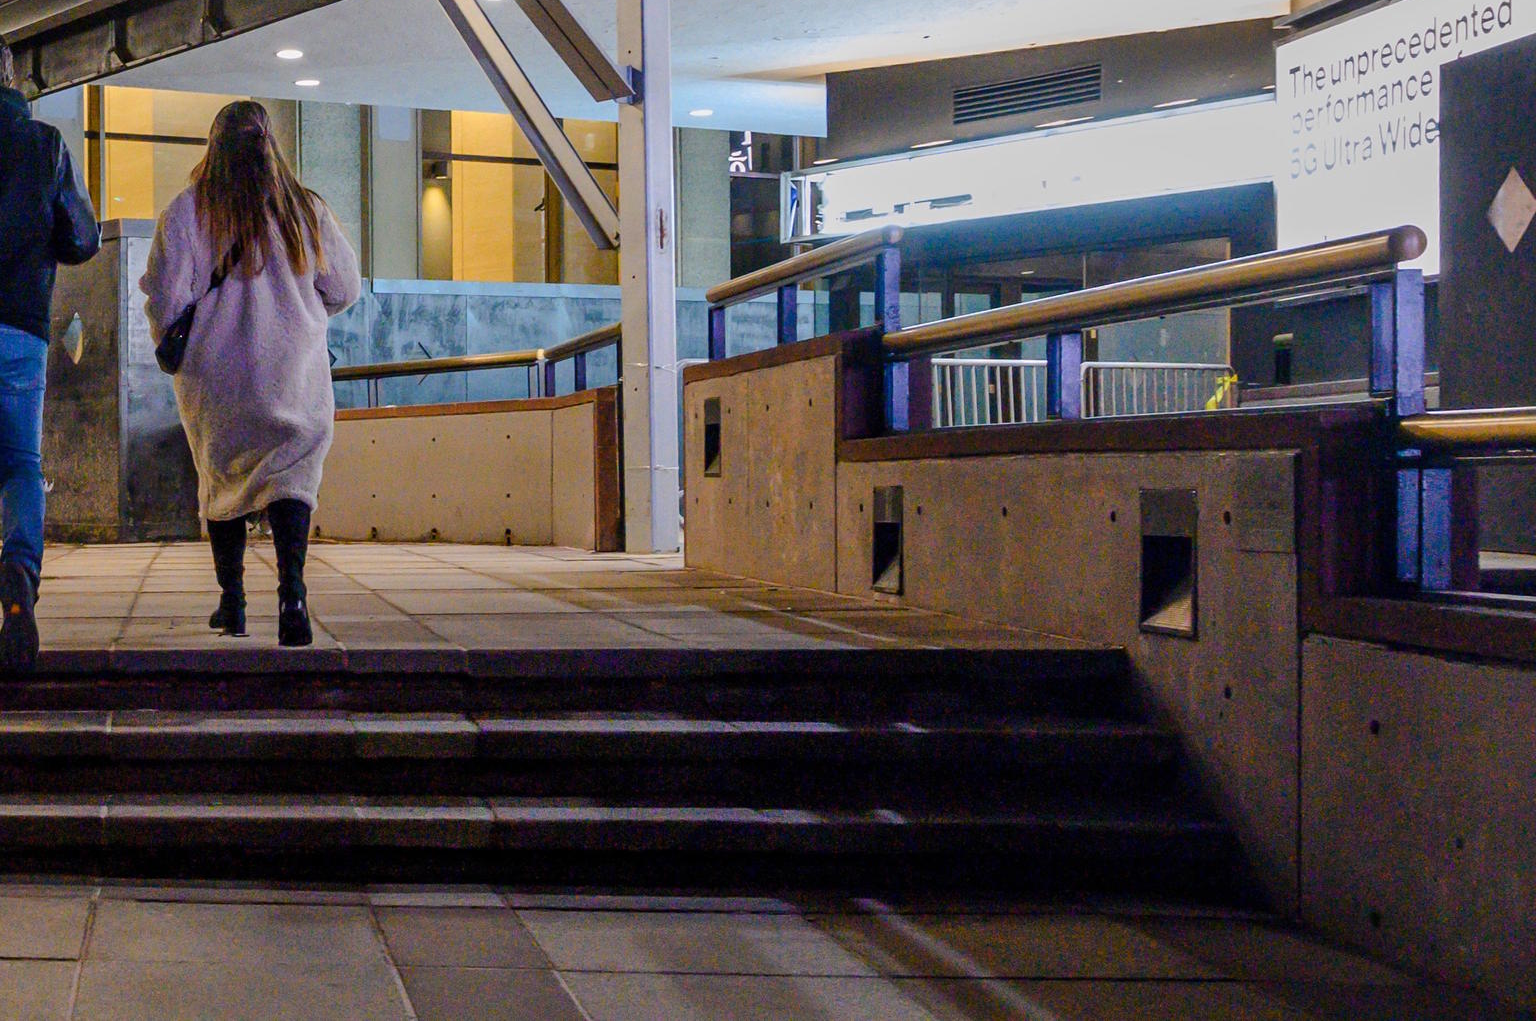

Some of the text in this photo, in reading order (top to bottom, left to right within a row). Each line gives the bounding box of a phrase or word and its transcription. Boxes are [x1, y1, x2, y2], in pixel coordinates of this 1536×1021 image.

[1289, 64, 1327, 99] The
[1292, 68, 1433, 136] performance
[1290, 143, 1318, 179] 5G
[1323, 135, 1373, 171] Ultra
